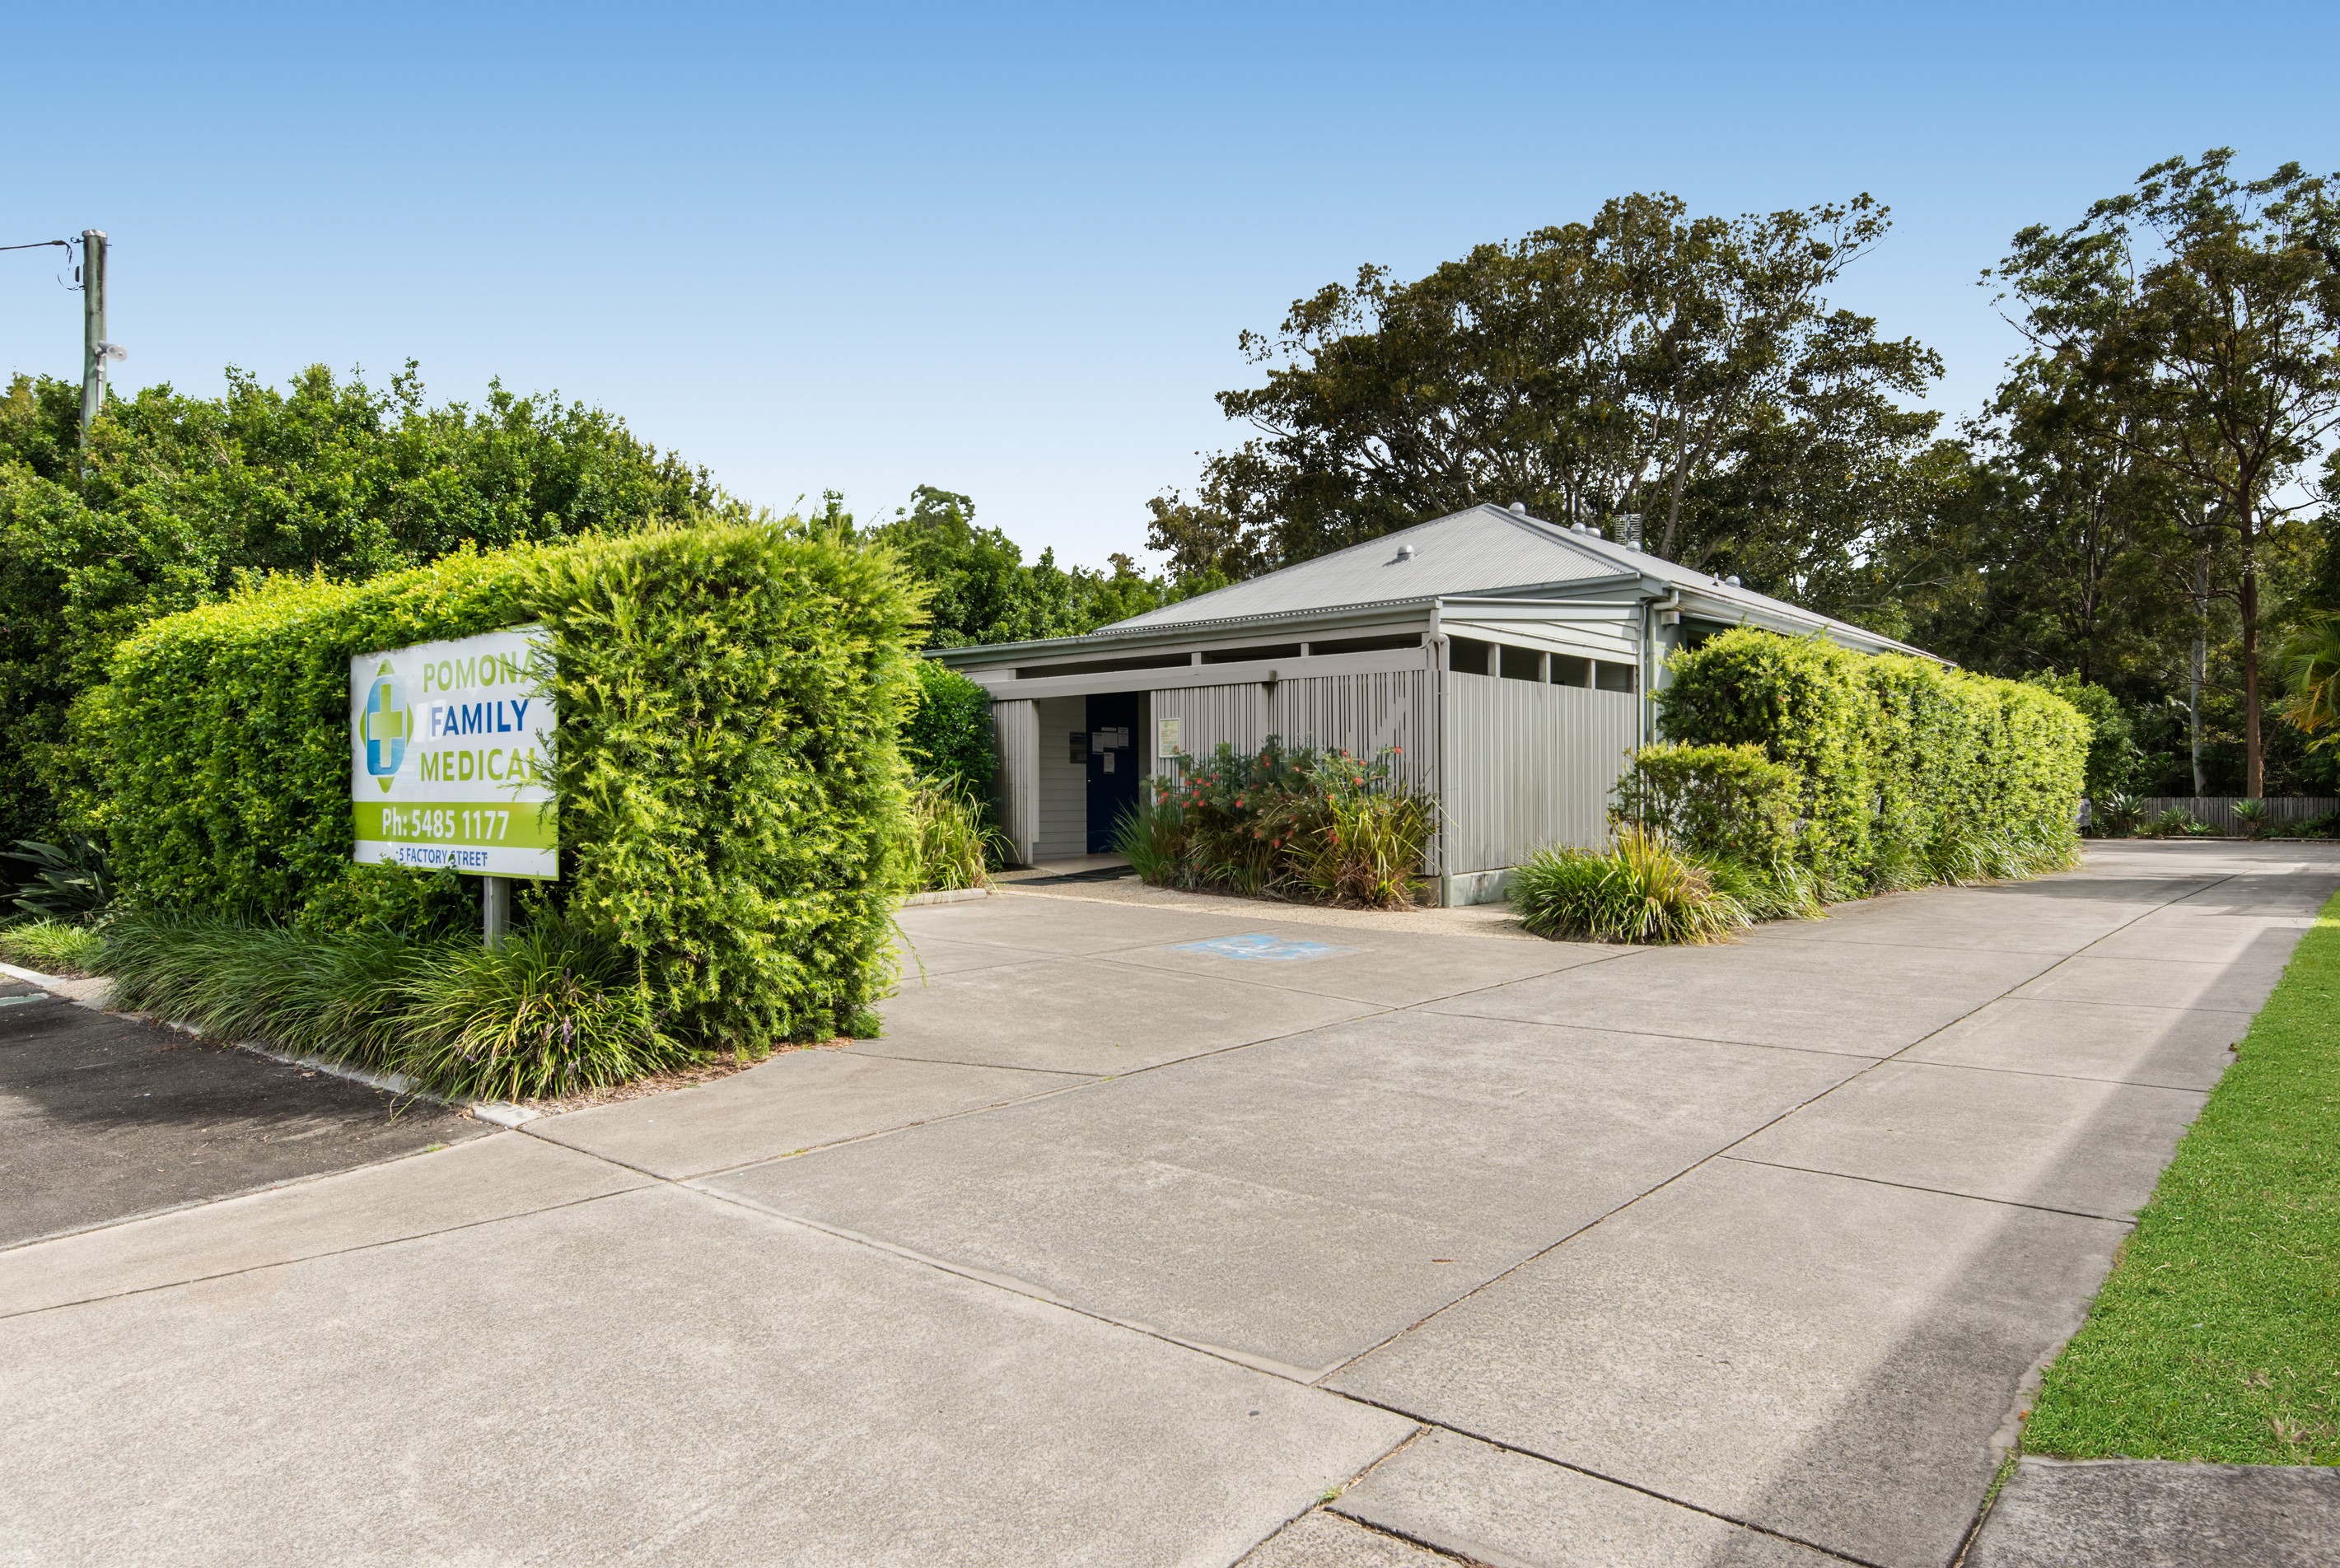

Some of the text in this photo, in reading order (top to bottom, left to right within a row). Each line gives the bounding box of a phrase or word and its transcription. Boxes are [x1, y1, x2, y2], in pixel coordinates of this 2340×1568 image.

[432, 699, 529, 736] FAMILY
[382, 807, 509, 840] Ph: 5485 1177
[406, 847, 448, 864] FACTORY
[451, 850, 488, 867] STREET
